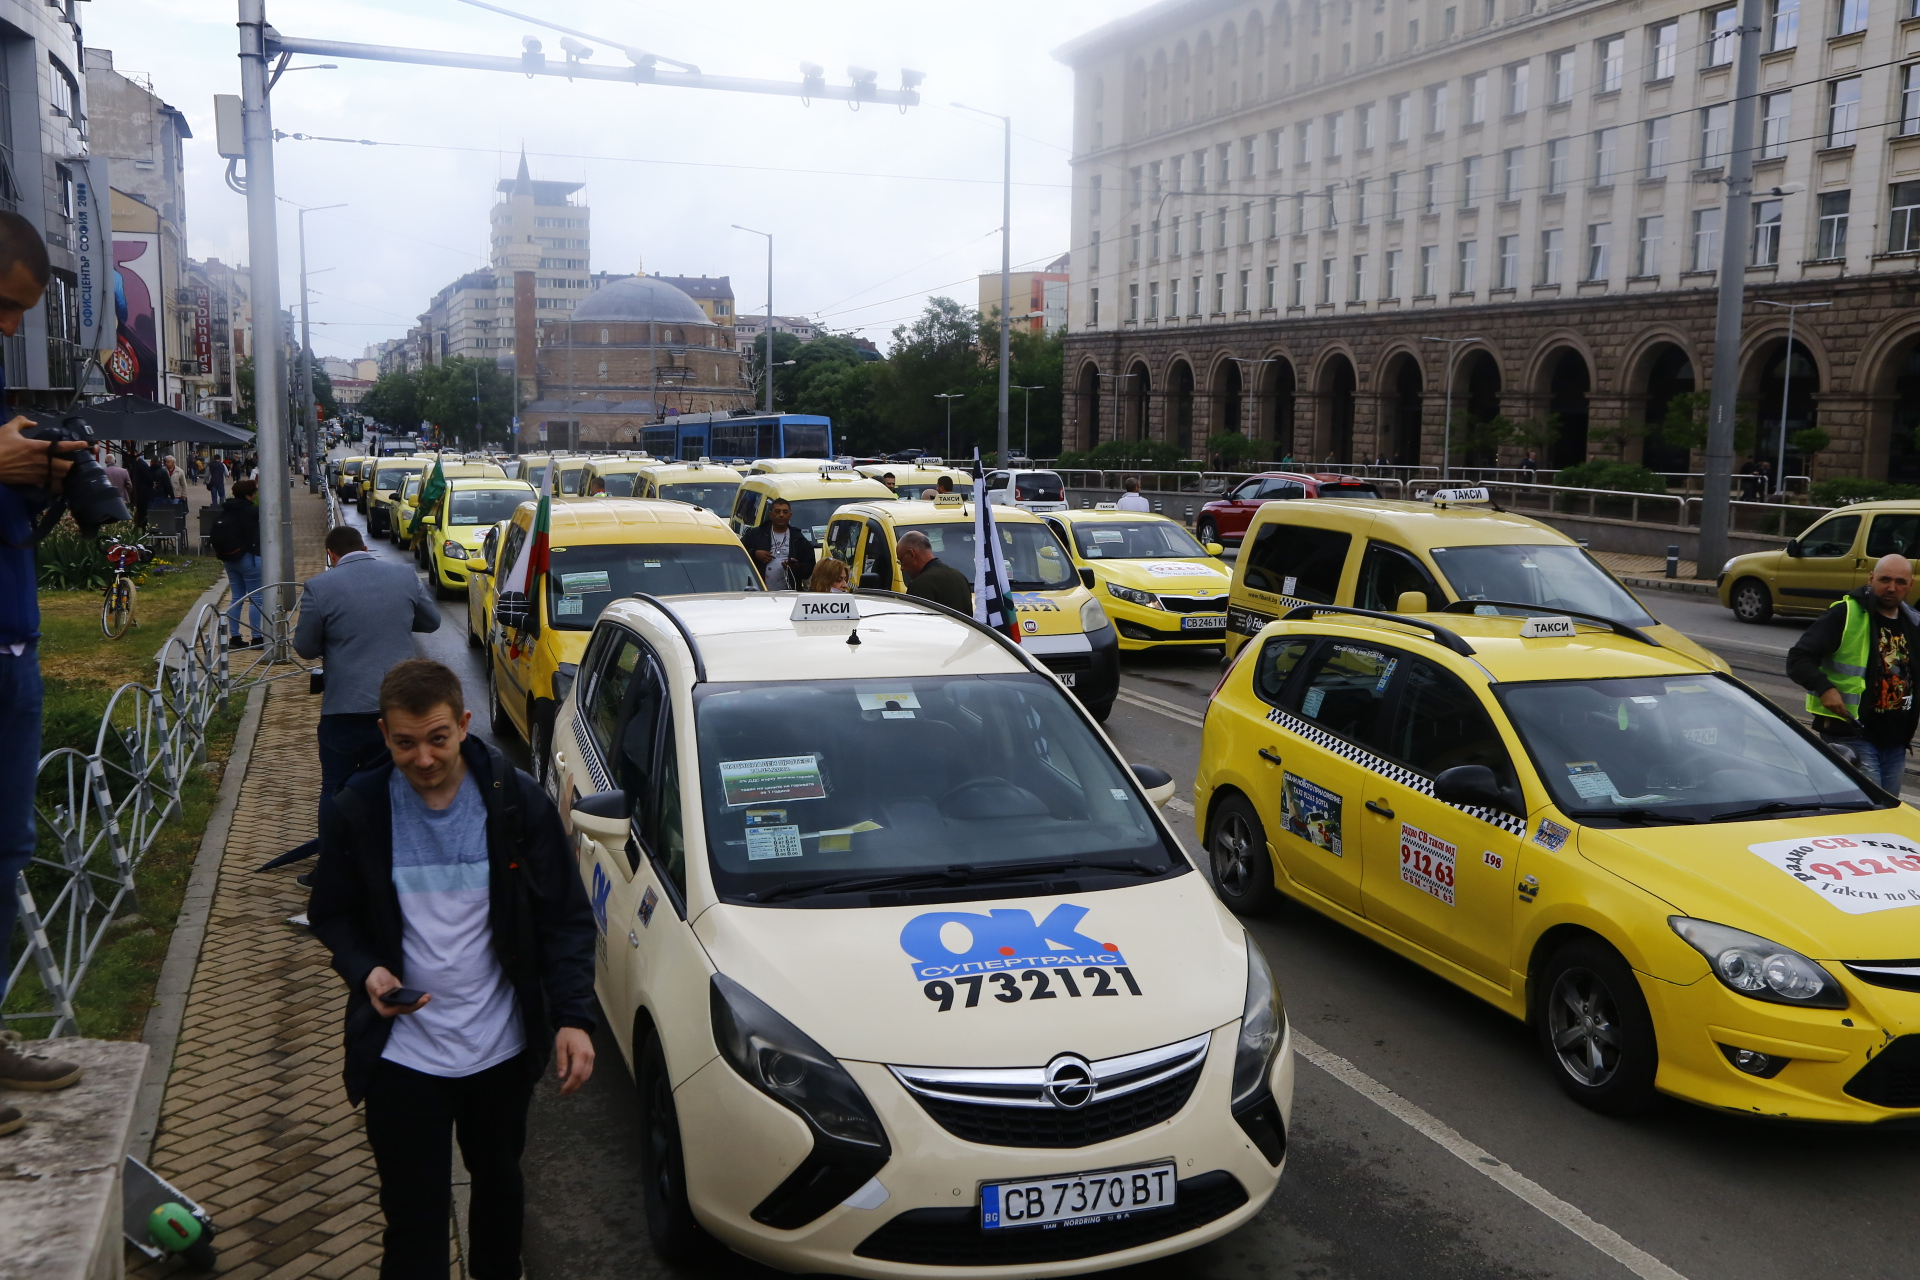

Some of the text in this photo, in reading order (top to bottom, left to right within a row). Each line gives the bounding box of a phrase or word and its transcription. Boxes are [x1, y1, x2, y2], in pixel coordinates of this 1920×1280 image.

[78, 212, 89, 252] СОФИЯ
[81, 256, 92, 327] ОФИСЦЕНТЪР
[197, 288, 209, 372] McDonald's
[1453, 490, 1482, 499] ТАКСИ
[802, 603, 850, 614] ТАКСИ
[1534, 623, 1568, 632] ТАКСИ
[1402, 825, 1417, 838] радио
[1429, 838, 1444, 852] такси
[1445, 846, 1455, 858] оод
[1484, 852, 1502, 869] 198
[1821, 881, 1880, 900] Такси
[1883, 892, 1906, 900] по
[920, 954, 1117, 977] СУПЕРТРАНС
[924, 966, 1142, 1012] 9732121
[985, 1212, 998, 1222] BG
[1064, 1216, 1100, 1227] NORDRING
